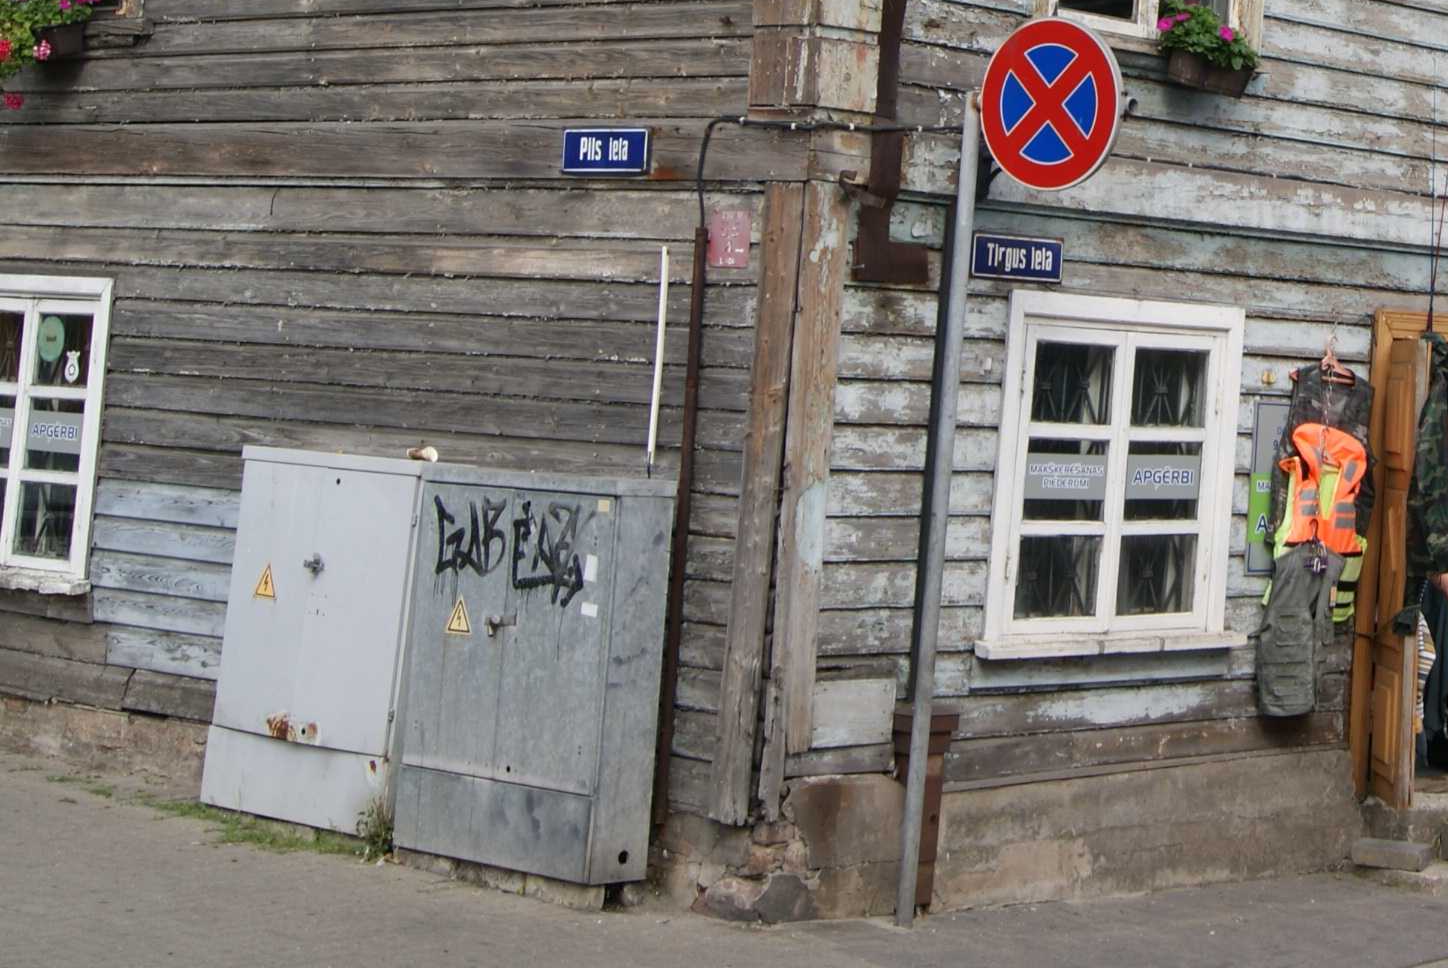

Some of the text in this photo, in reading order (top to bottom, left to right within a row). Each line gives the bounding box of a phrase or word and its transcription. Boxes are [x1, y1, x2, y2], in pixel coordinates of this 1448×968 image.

[579, 137, 629, 161] Pils iela
[987, 242, 1053, 272] Tirgus iela
